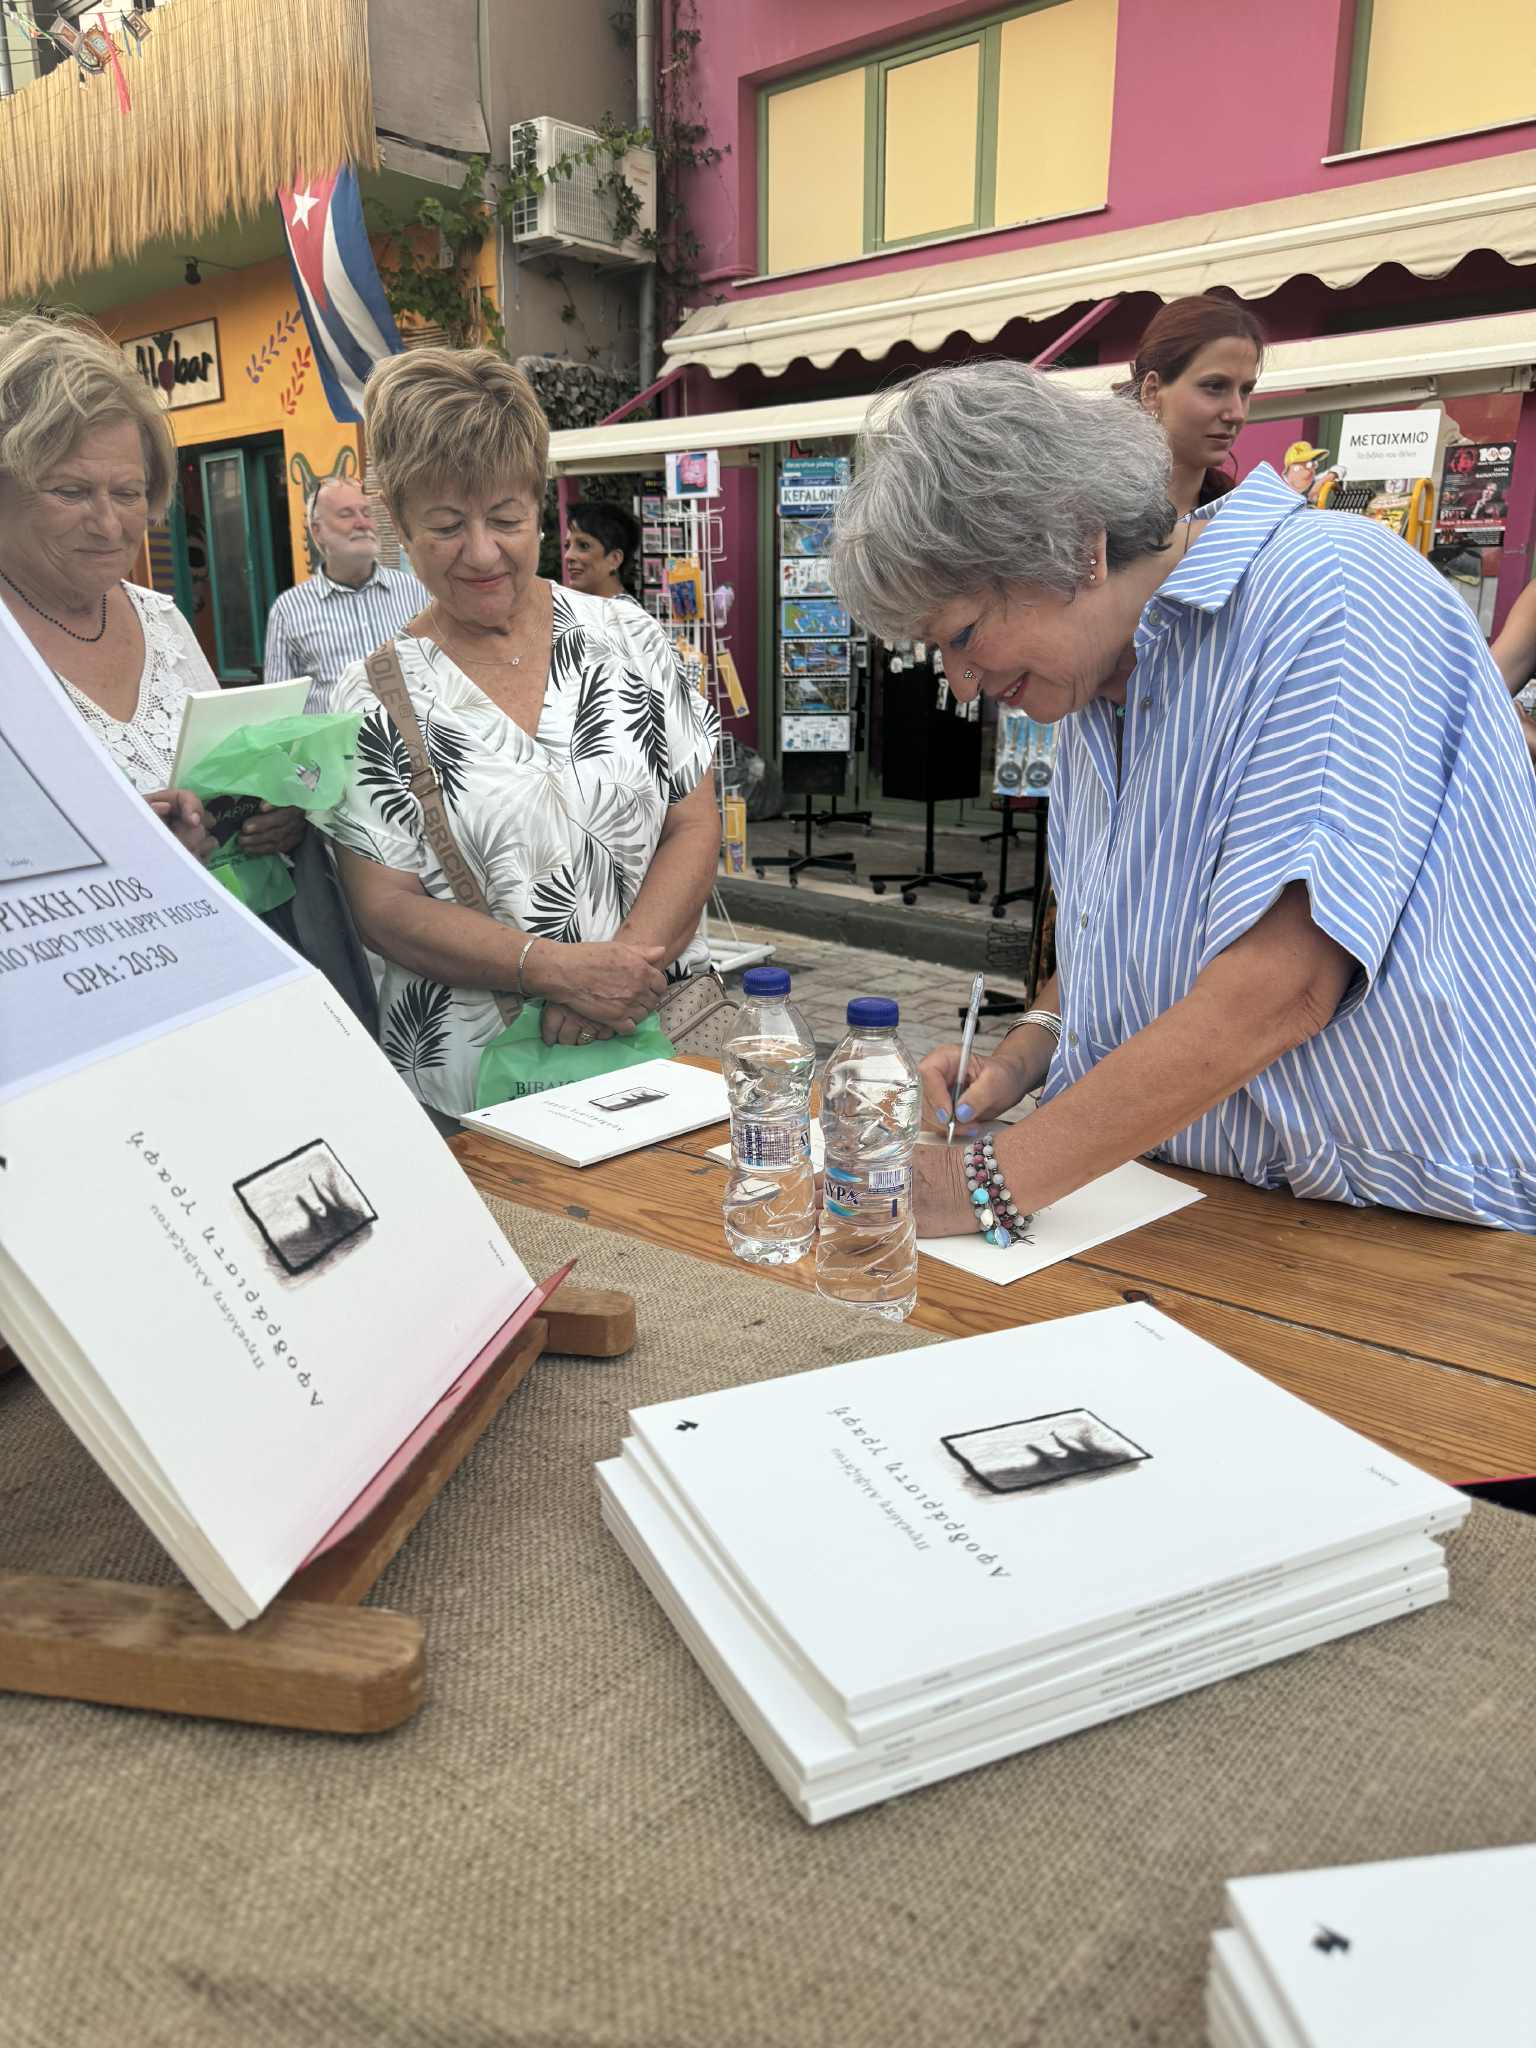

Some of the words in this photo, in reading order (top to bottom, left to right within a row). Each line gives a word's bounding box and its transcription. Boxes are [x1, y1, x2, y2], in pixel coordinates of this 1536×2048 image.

[0, 890, 86, 932] ΡΙΑΚΗ
[77, 875, 153, 911] 10/08
[21, 933, 79, 964] ΧΩΡΟ
[72, 923, 116, 949] ΤΟΥ
[108, 910, 168, 940] HAPPY
[161, 898, 220, 926] HOUSE
[63, 962, 126, 996] ΩΡΑ:
[118, 943, 178, 977] 20:30
[125, 1130, 197, 1217] γραφή
[825, 1404, 889, 1456] γραφή
